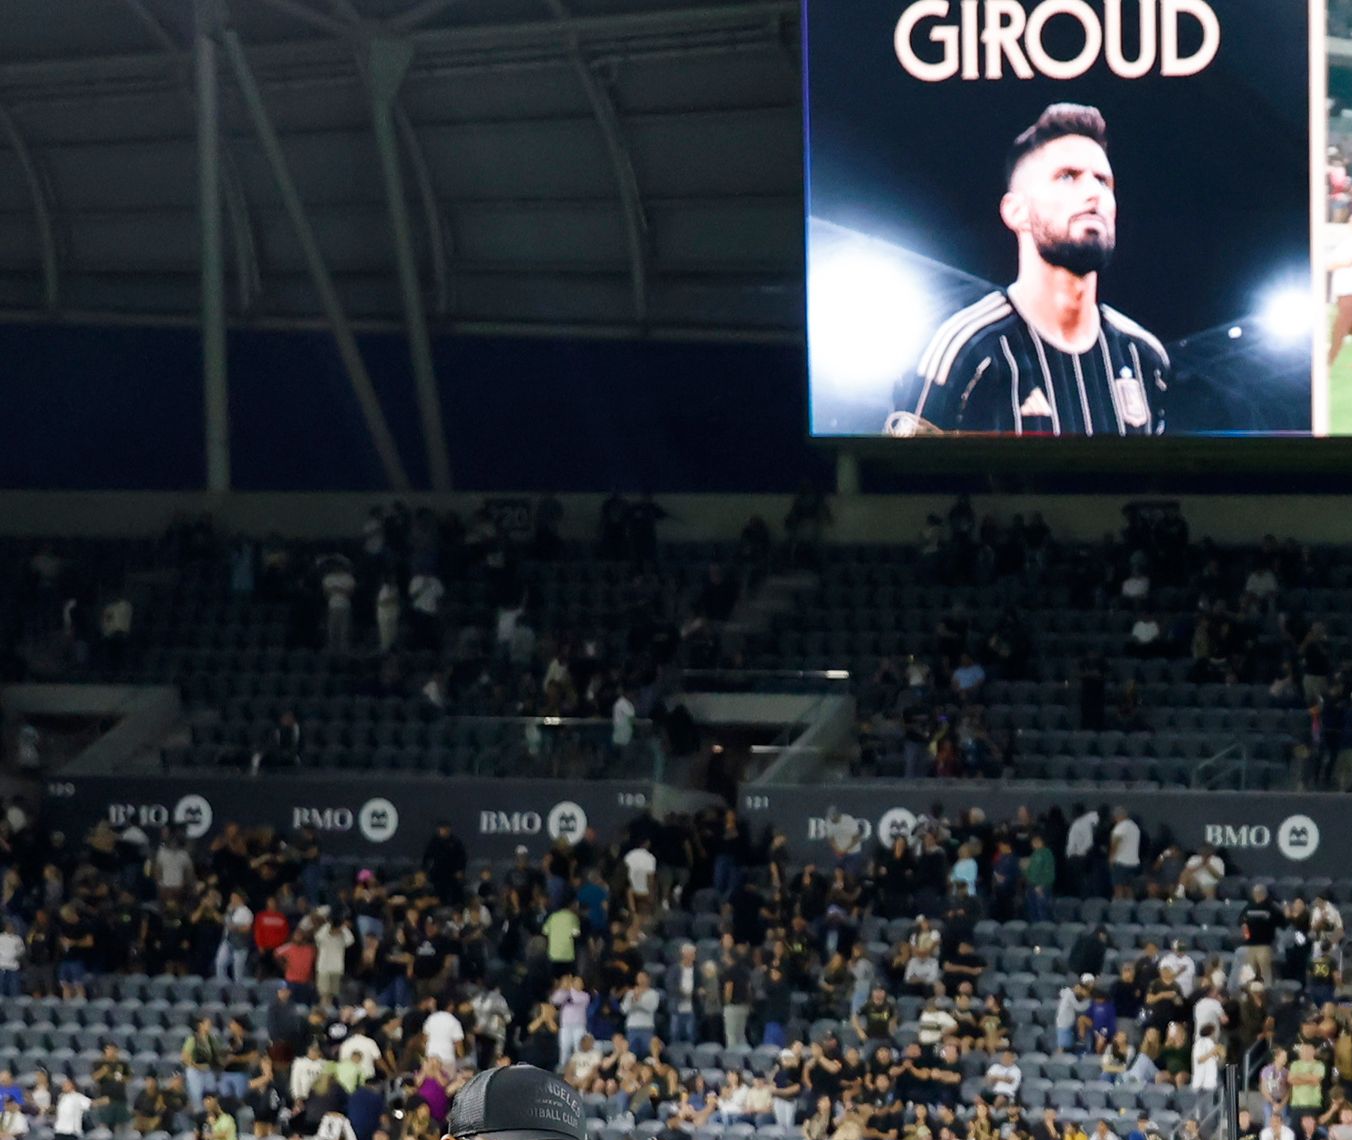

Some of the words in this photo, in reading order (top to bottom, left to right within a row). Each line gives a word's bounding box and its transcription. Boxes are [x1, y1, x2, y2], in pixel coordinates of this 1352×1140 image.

[894, 0, 1220, 82] GIROUD
[292, 806, 354, 832] BMO
[479, 810, 543, 835] BMO
[807, 816, 872, 841] BO
[1205, 824, 1271, 848] BMO
